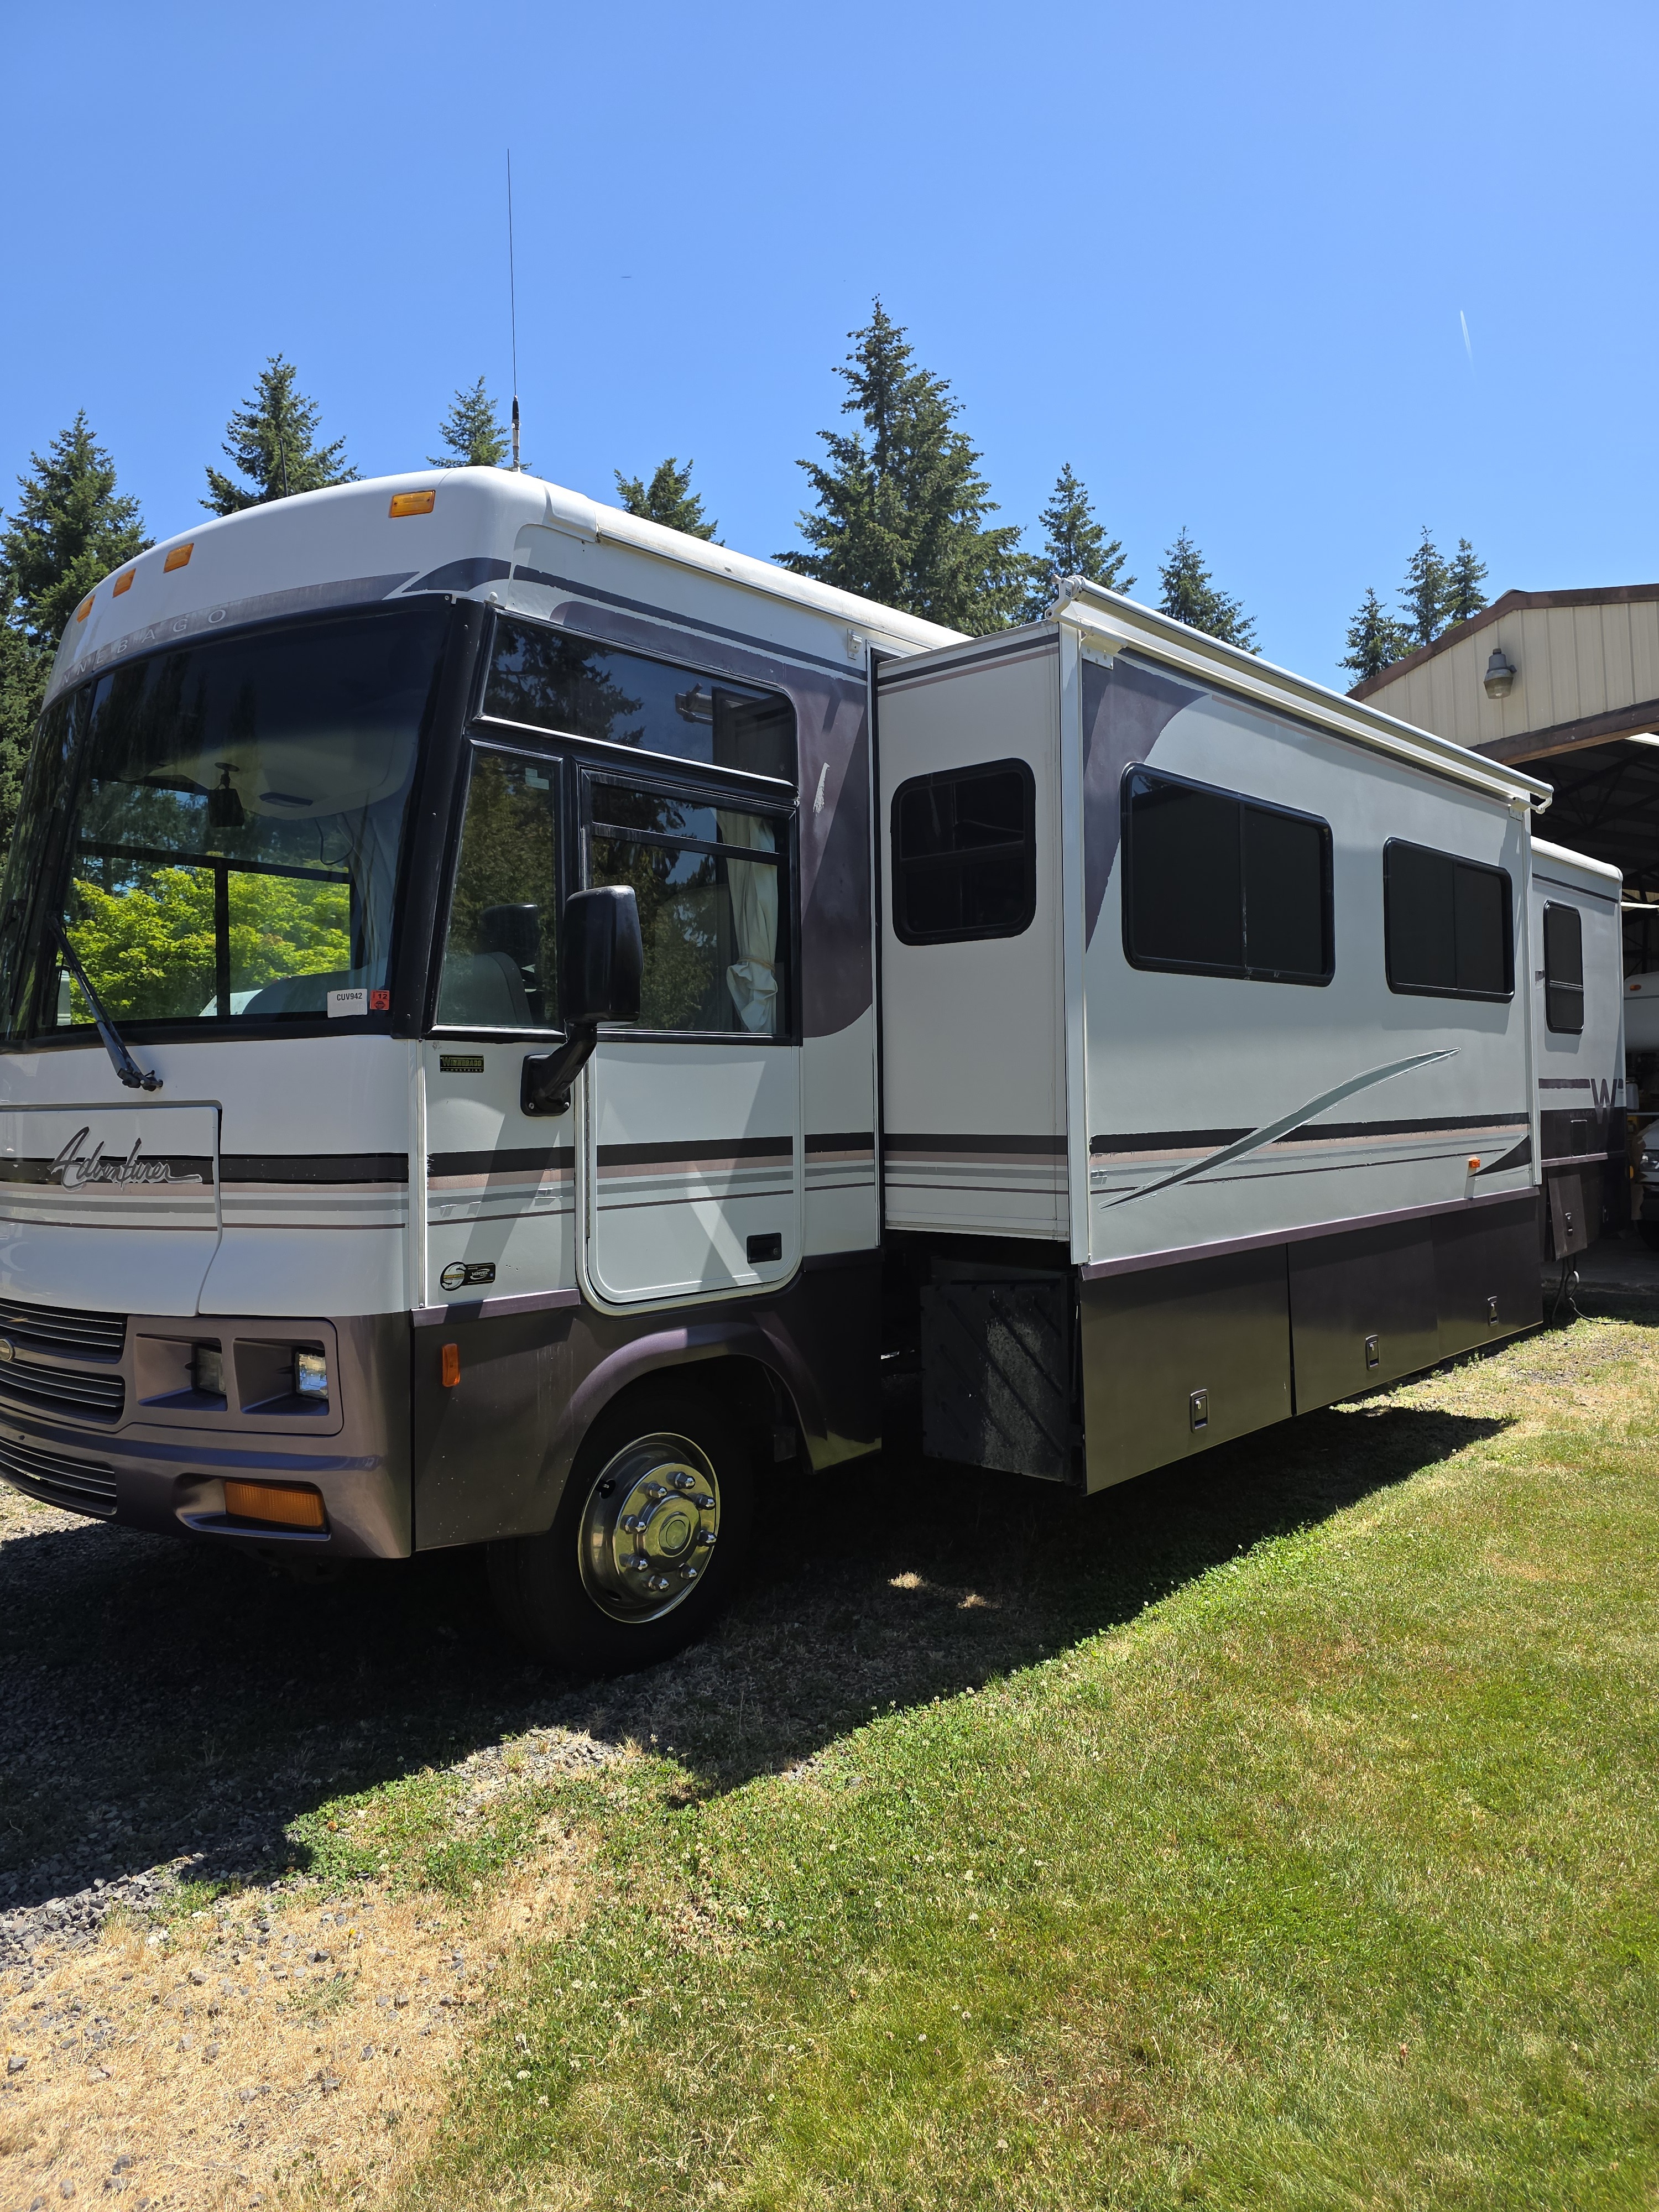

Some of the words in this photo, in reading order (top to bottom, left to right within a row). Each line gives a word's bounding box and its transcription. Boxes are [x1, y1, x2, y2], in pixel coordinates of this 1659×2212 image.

[62, 609, 226, 685] NNEBAGO
[336, 992, 363, 1001] CUV942
[47, 1126, 202, 1192] Adventurer
